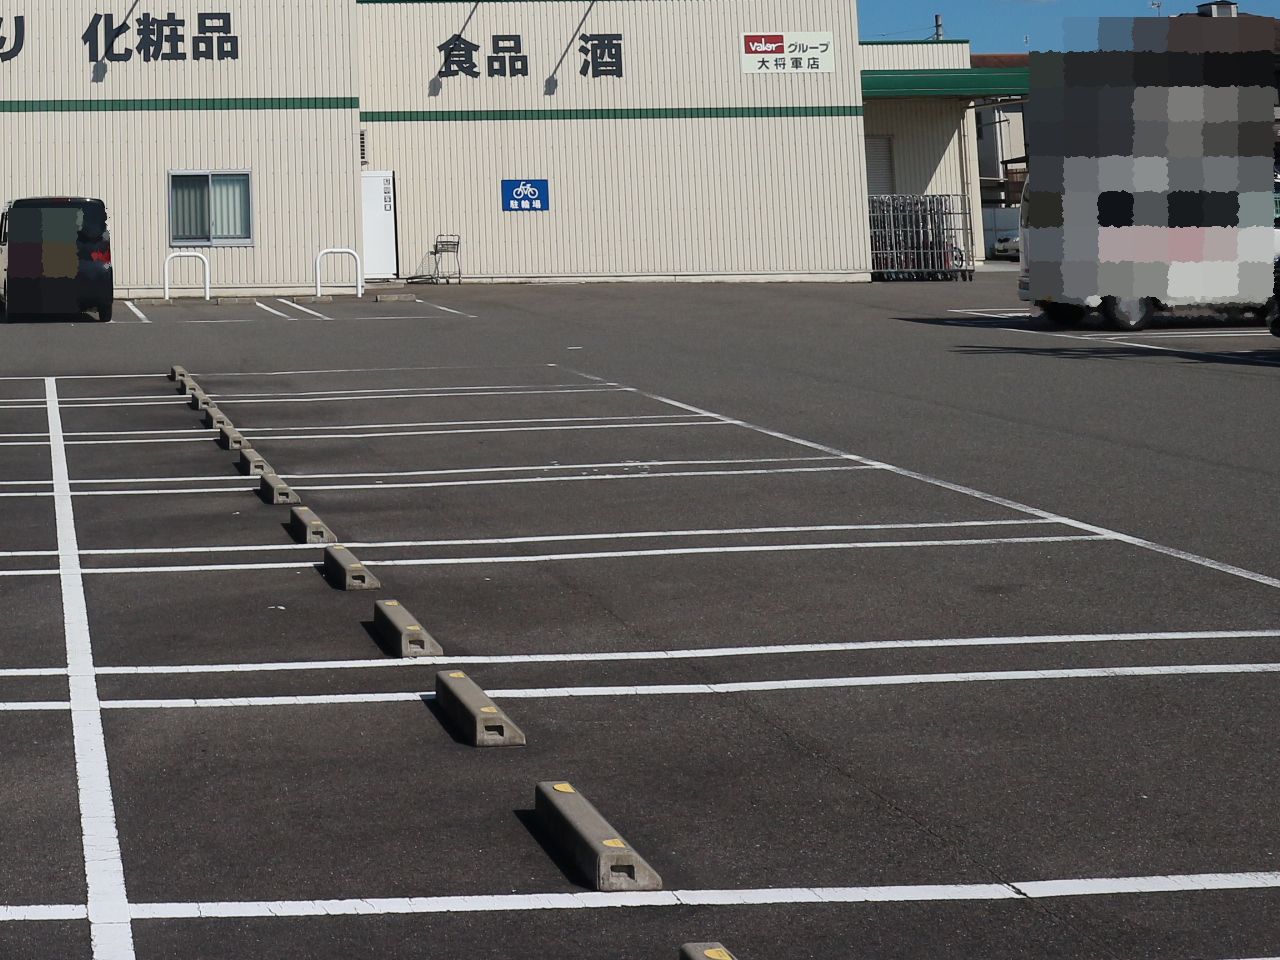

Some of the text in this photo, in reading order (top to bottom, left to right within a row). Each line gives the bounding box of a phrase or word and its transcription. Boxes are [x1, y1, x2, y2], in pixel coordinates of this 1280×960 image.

[81, 12, 239, 62] 化粧品
[787, 41, 831, 54] グループ
[437, 33, 623, 78] 食品 酒
[757, 57, 819, 70] 大将軍店
